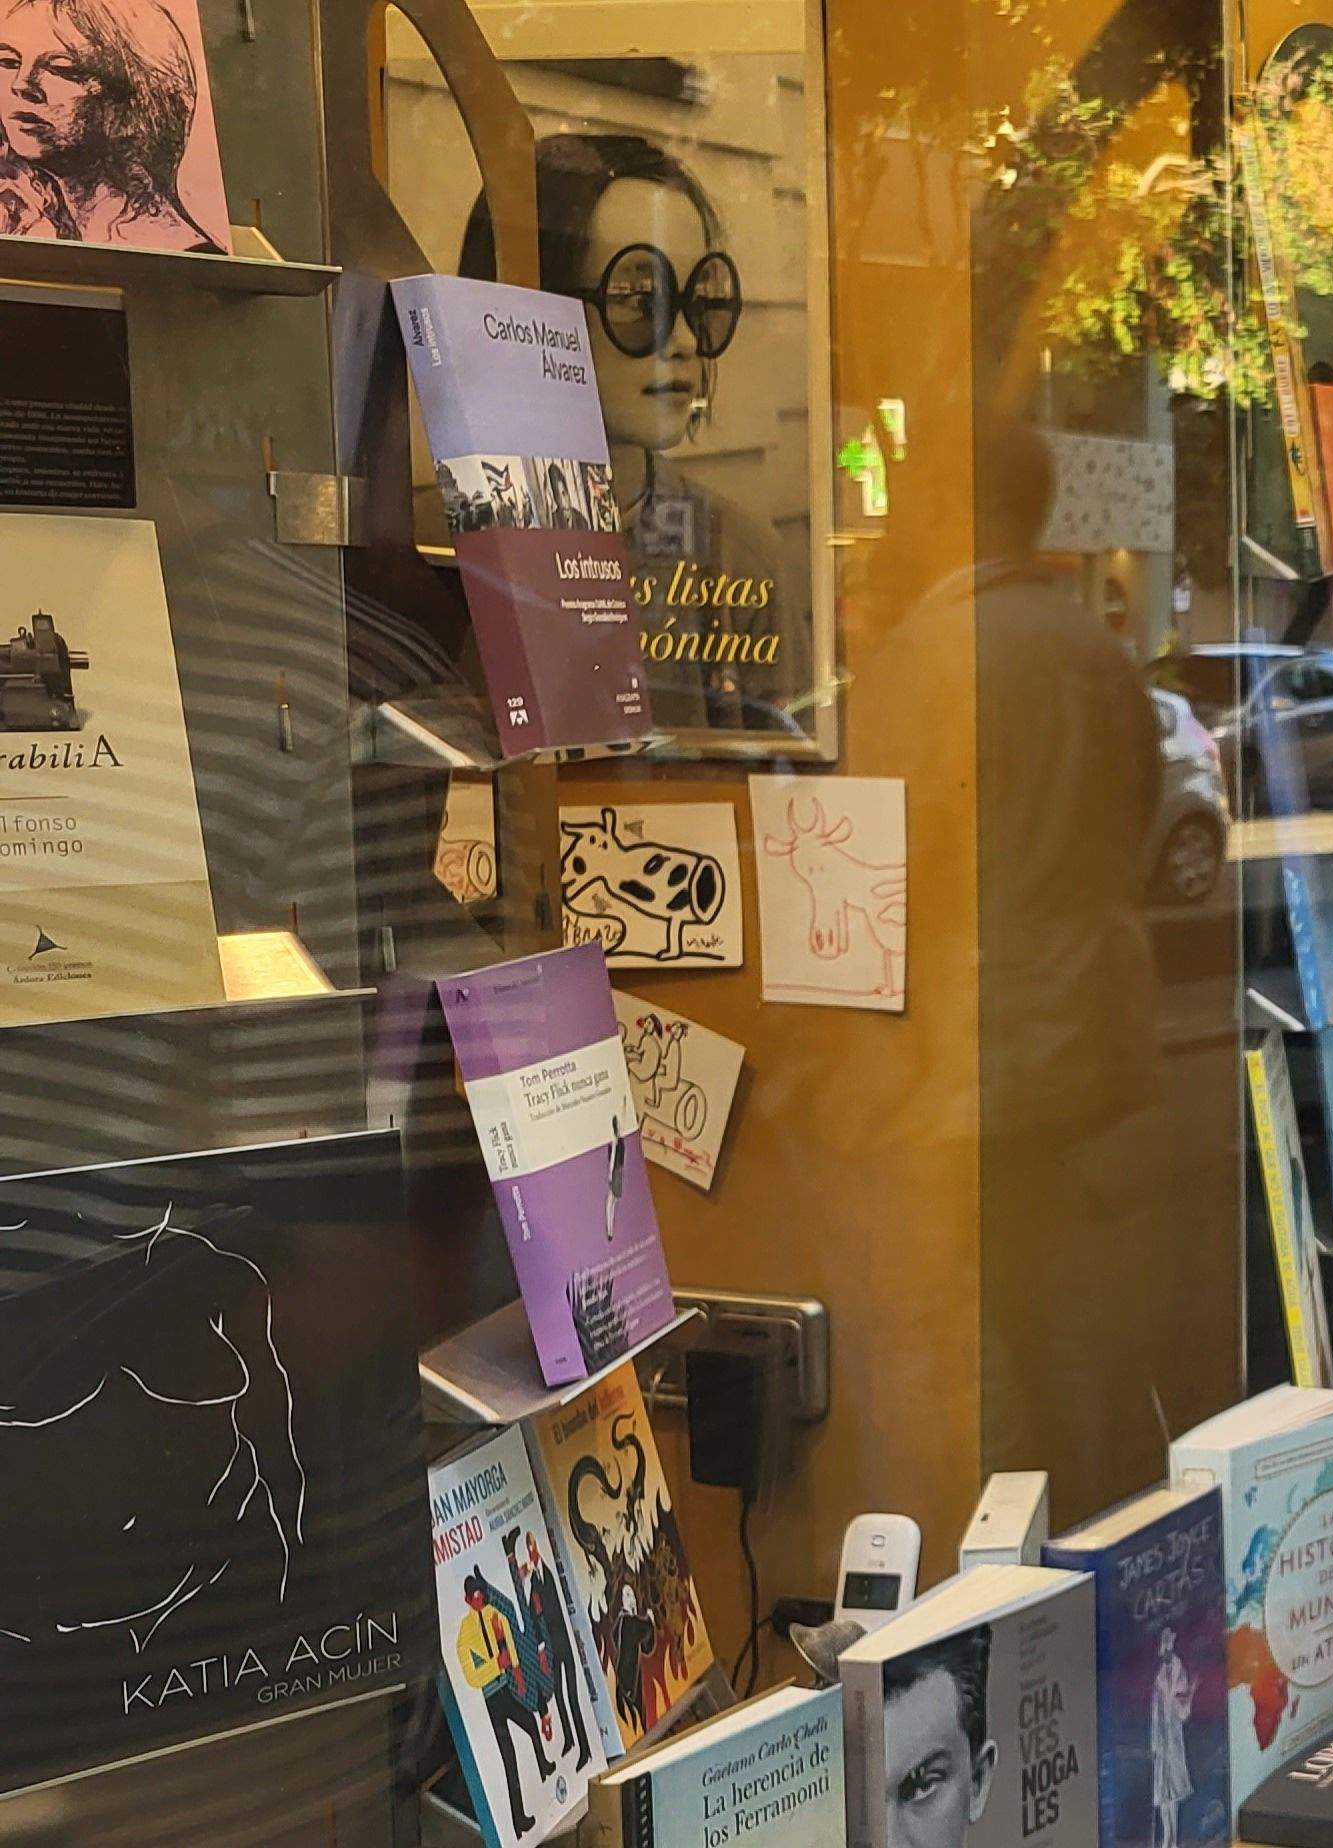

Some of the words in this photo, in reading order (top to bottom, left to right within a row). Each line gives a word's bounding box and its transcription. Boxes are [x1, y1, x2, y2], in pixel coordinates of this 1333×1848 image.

[483, 313, 534, 346] Carlos
[532, 320, 582, 352] Manuel
[542, 349, 587, 385] Álvarez
[555, 551, 580, 580] Los
[578, 552, 622, 581] intrusos
[666, 559, 775, 609] listas
[519, 1073, 541, 1089] Tom
[541, 1060, 577, 1083] Perrotta
[431, 1491, 455, 1529] AN
[452, 1461, 508, 1515] MAYORGA
[122, 1648, 269, 1714] KATIA
[285, 1612, 399, 1673] ACÍN
[257, 1672, 323, 1704] GRAN
[329, 1653, 402, 1686] MUJER
[1018, 1681, 1064, 1729] CHA
[701, 1754, 756, 1787] Gaetano
[758, 1734, 792, 1761] Carlo
[1018, 1719, 1060, 1765] VES
[702, 1794, 726, 1820] La
[730, 1756, 805, 1808] herencia
[809, 1742, 831, 1769] de
[1021, 1744, 1080, 1802] NOGA
[703, 1826, 730, 1848] los
[735, 1768, 831, 1837] Ferramonti
[1021, 1790, 1060, 1838] LES
